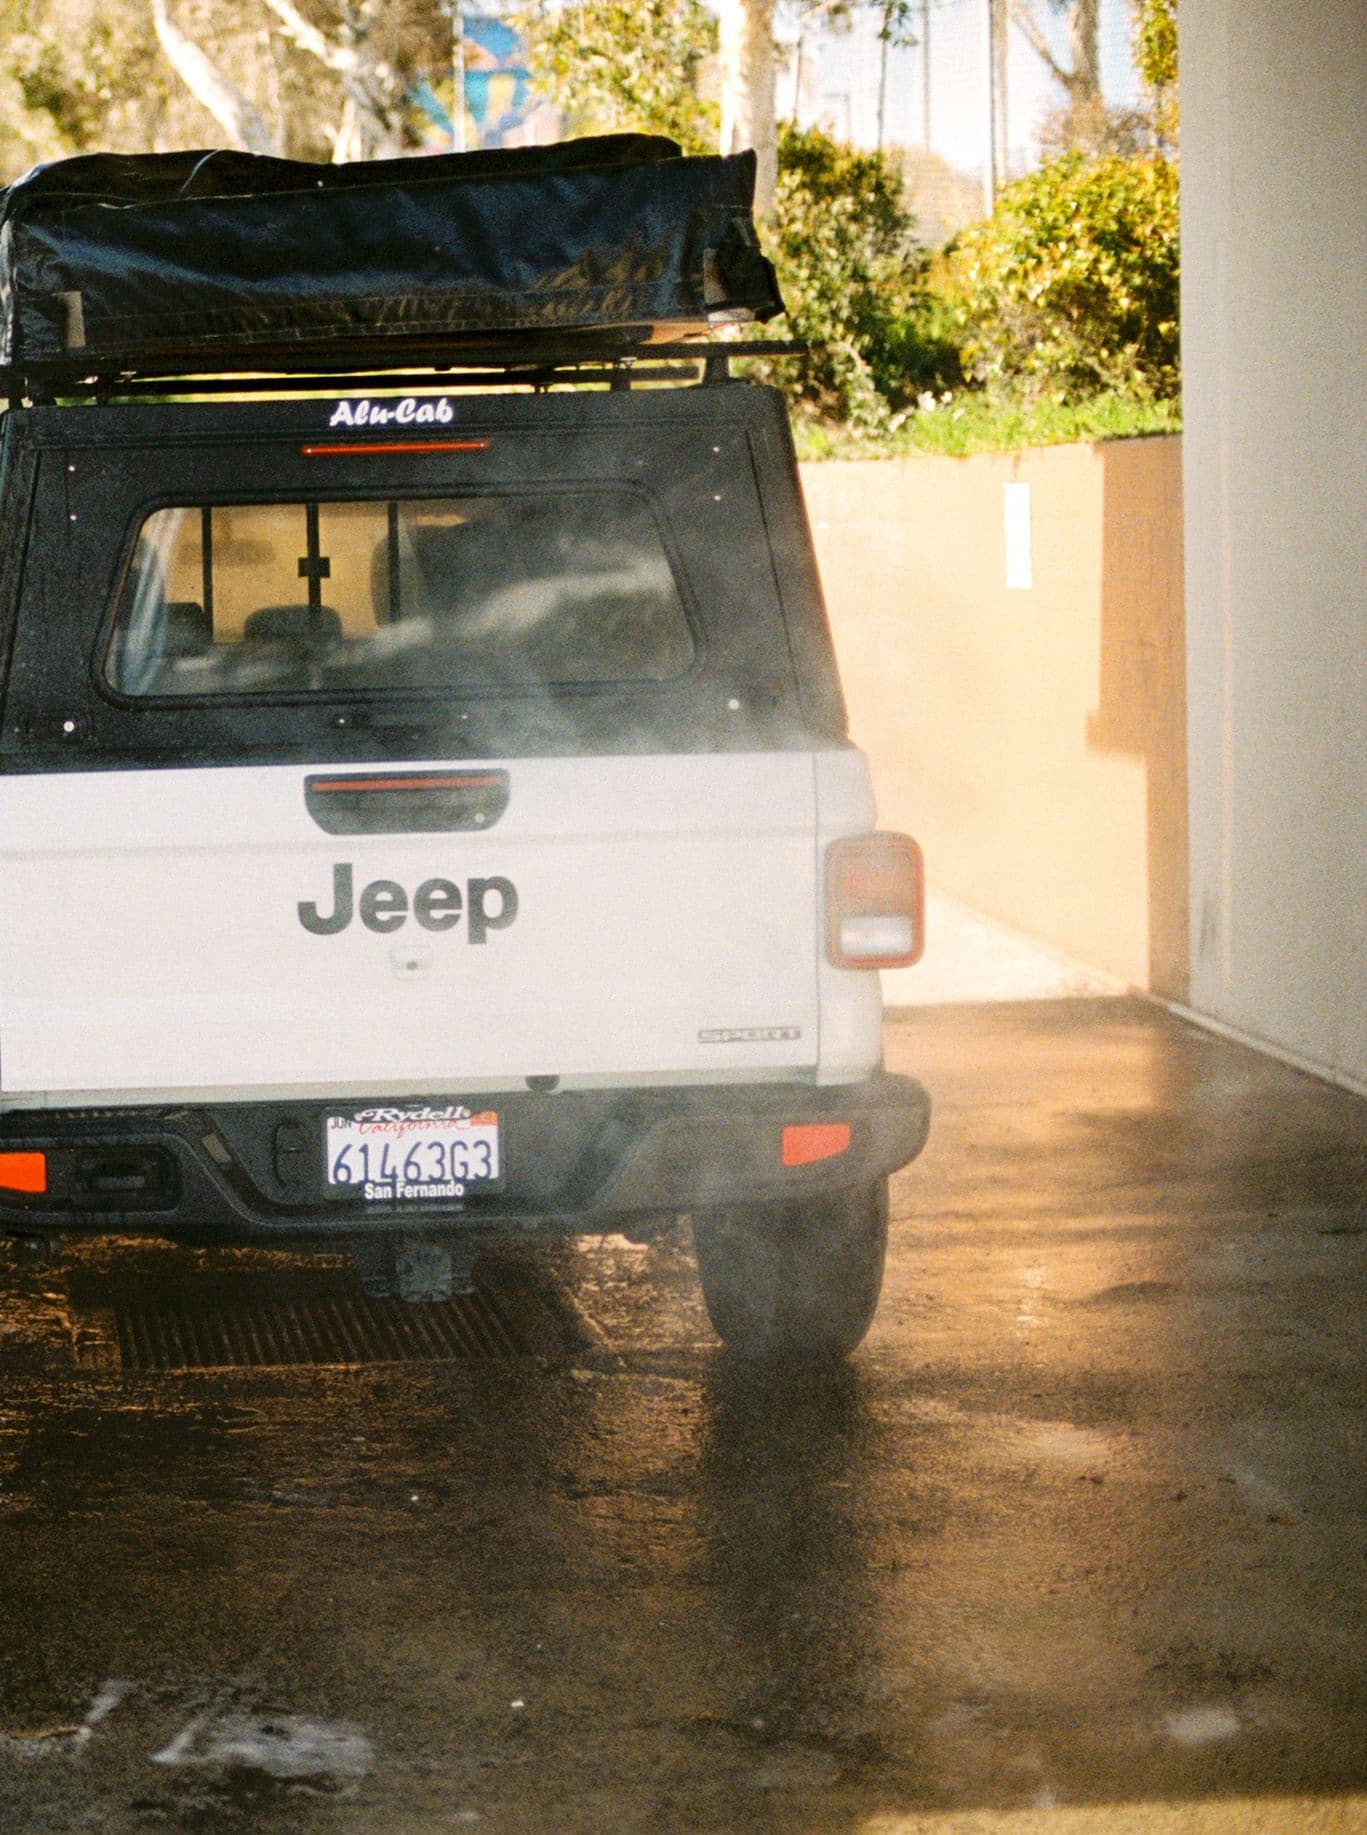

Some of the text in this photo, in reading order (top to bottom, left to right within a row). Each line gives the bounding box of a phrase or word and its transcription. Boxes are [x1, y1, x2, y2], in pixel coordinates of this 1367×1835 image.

[329, 397, 454, 427] Alu-Cab
[298, 863, 519, 944] Jeep
[698, 1026, 801, 1044] SPORT
[361, 1106, 464, 1122] Rydell
[333, 1140, 491, 1184] 61463G3
[364, 1181, 465, 1199] San Fernando
